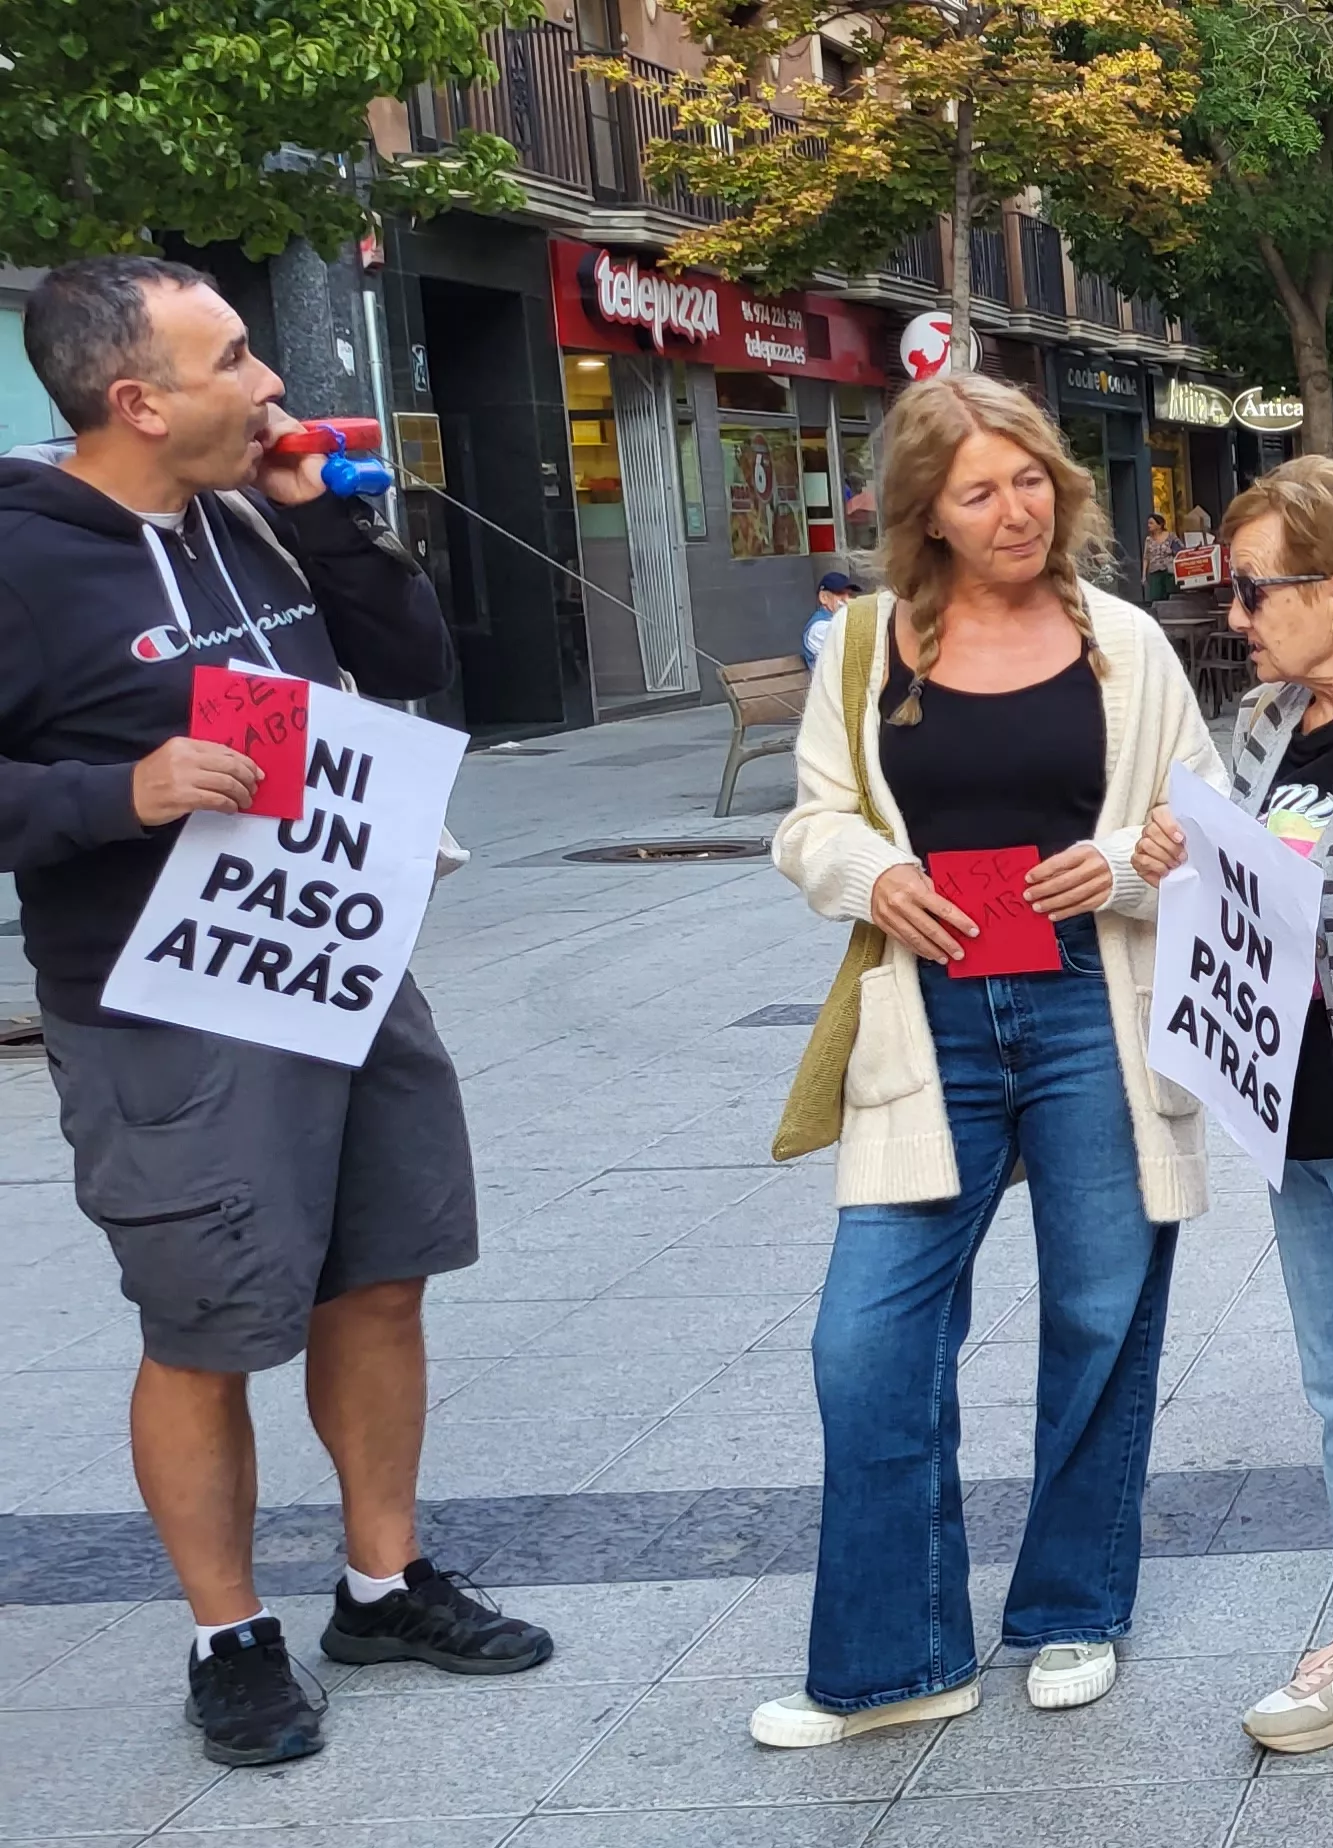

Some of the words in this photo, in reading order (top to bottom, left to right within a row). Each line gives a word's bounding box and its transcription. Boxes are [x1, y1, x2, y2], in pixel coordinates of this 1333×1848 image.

[599, 252, 720, 350] telepizza
[753, 303, 770, 325] 974
[745, 329, 806, 367] telepizza.es
[1241, 394, 1303, 417] Ártica
[305, 737, 374, 803] NI
[277, 808, 372, 872] UN
[200, 852, 384, 941] PASO
[1217, 846, 1261, 919] NI
[144, 918, 384, 1012] ATRÁS
[1219, 894, 1273, 985] UN
[1189, 935, 1281, 1058] PASO
[1166, 994, 1282, 1134] ATRÁS
